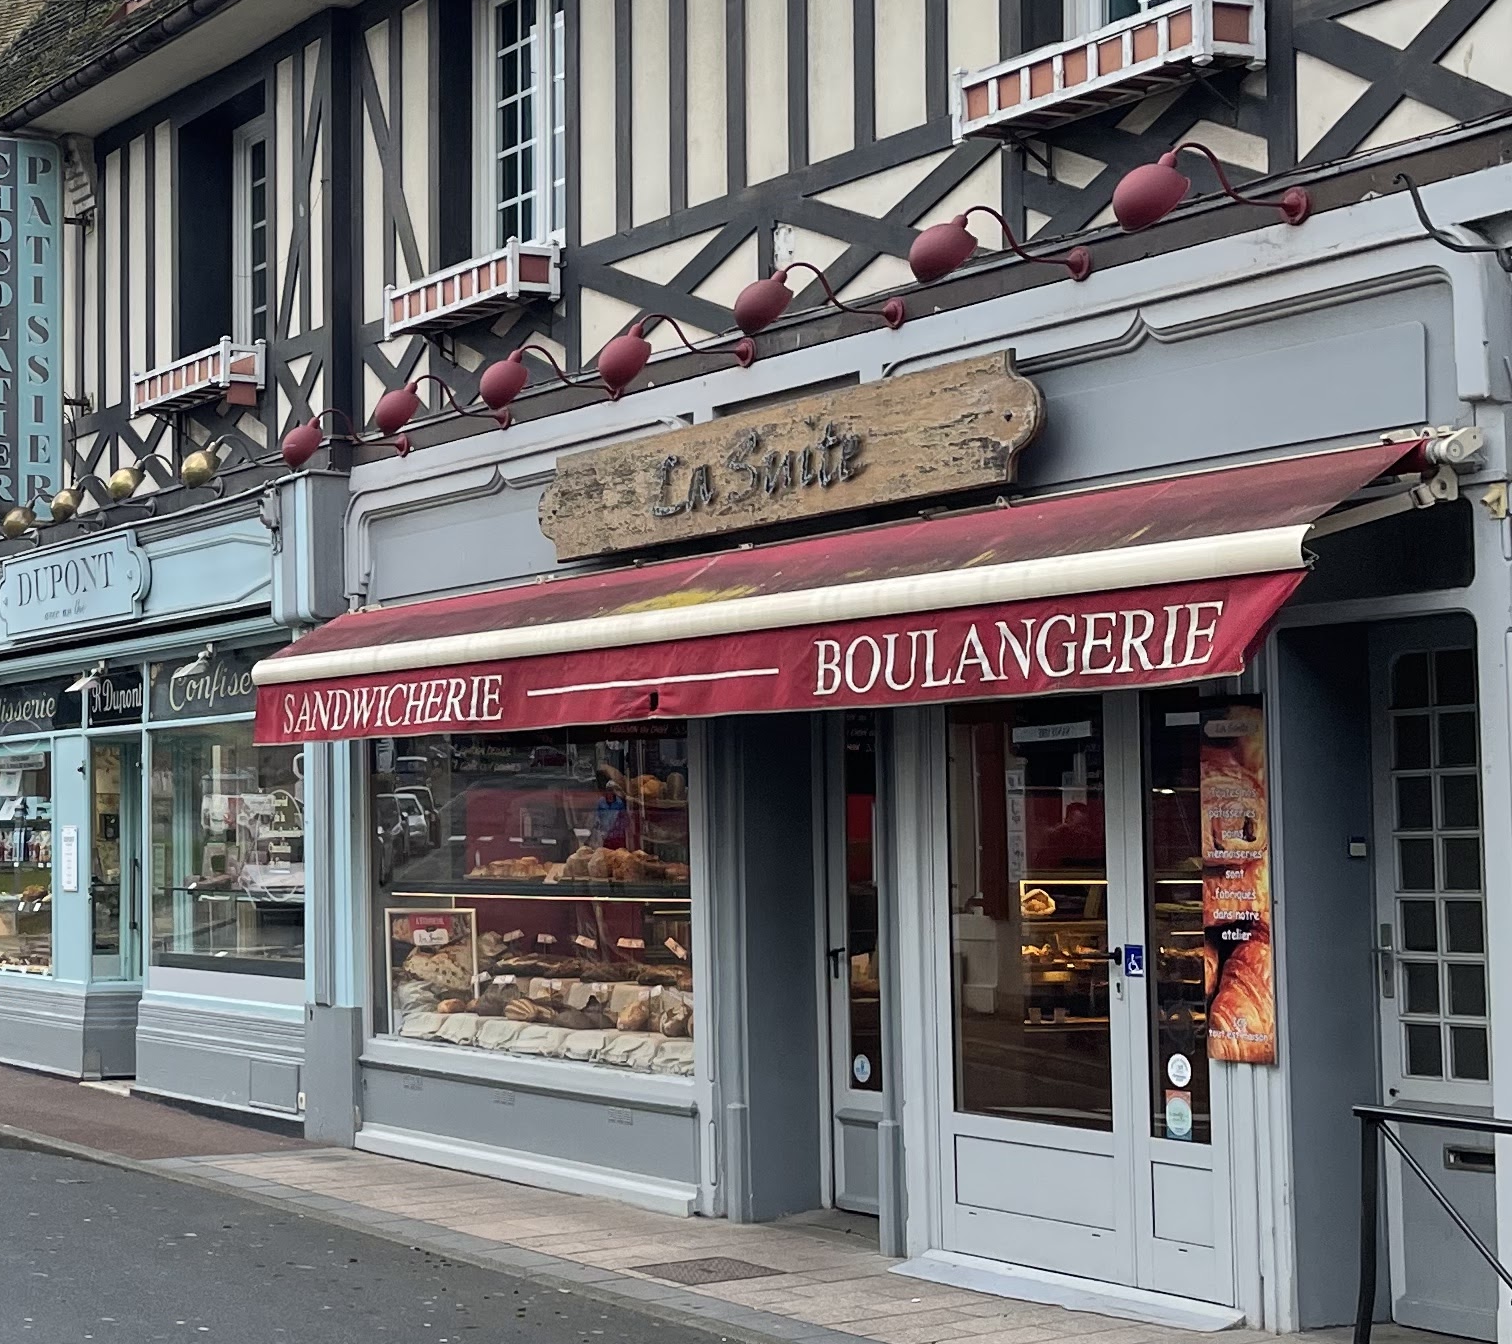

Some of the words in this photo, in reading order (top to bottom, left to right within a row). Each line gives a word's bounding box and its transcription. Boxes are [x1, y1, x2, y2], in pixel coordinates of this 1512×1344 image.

[24, 156, 53, 504] PATISSIER
[726, 415, 863, 505] Suite
[17, 551, 115, 607] DUPONT
[813, 600, 1224, 696] BOULANGERIE
[104, 679, 143, 715] Dupont
[169, 659, 255, 712] Confise
[283, 674, 504, 735] SANDWICHERIE
[1207, 849, 1263, 860] viennoiseries
[1225, 868, 1245, 879] sont
[1213, 909, 1234, 920] dans
[1235, 910, 1260, 921] notre
[1221, 928, 1252, 941] atelier
[1208, 1029, 1225, 1039] tout
